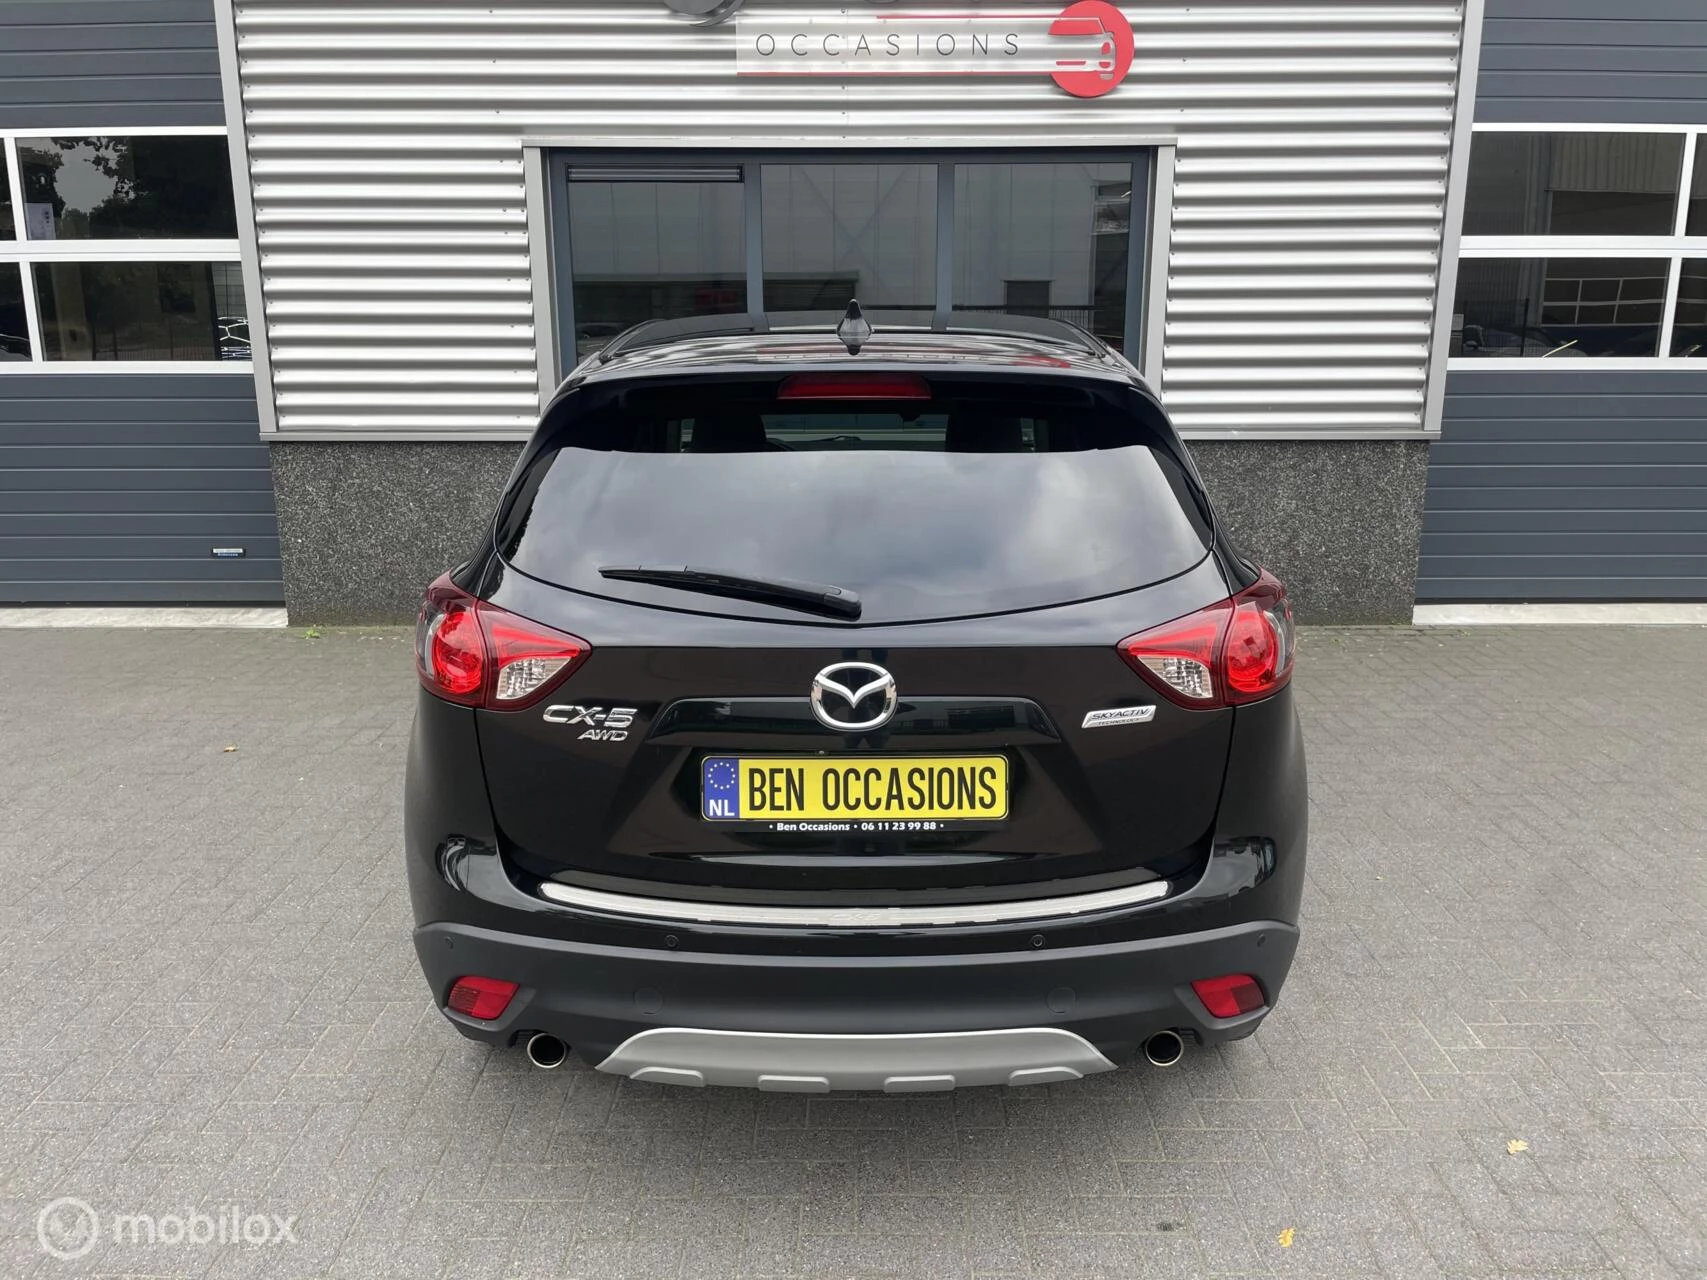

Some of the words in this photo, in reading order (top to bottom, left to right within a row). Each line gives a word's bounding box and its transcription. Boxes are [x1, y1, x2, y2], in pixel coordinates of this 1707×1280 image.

[755, 33, 1019, 56] OCCASIONS
[542, 704, 638, 728] CX-5
[1091, 708, 1149, 720] SKYACTIV
[577, 729, 629, 742] AWD
[748, 768, 805, 812] BEN
[822, 766, 997, 811] OCCASIONS
[709, 799, 735, 817] NL
[776, 822, 797, 831] Ben
[799, 822, 850, 831] Occasions
[861, 822, 875, 831] 06
[878, 822, 889, 831] 11
[892, 822, 905, 831] 23
[907, 822, 922, 831] 99
[923, 822, 936, 831] 88
